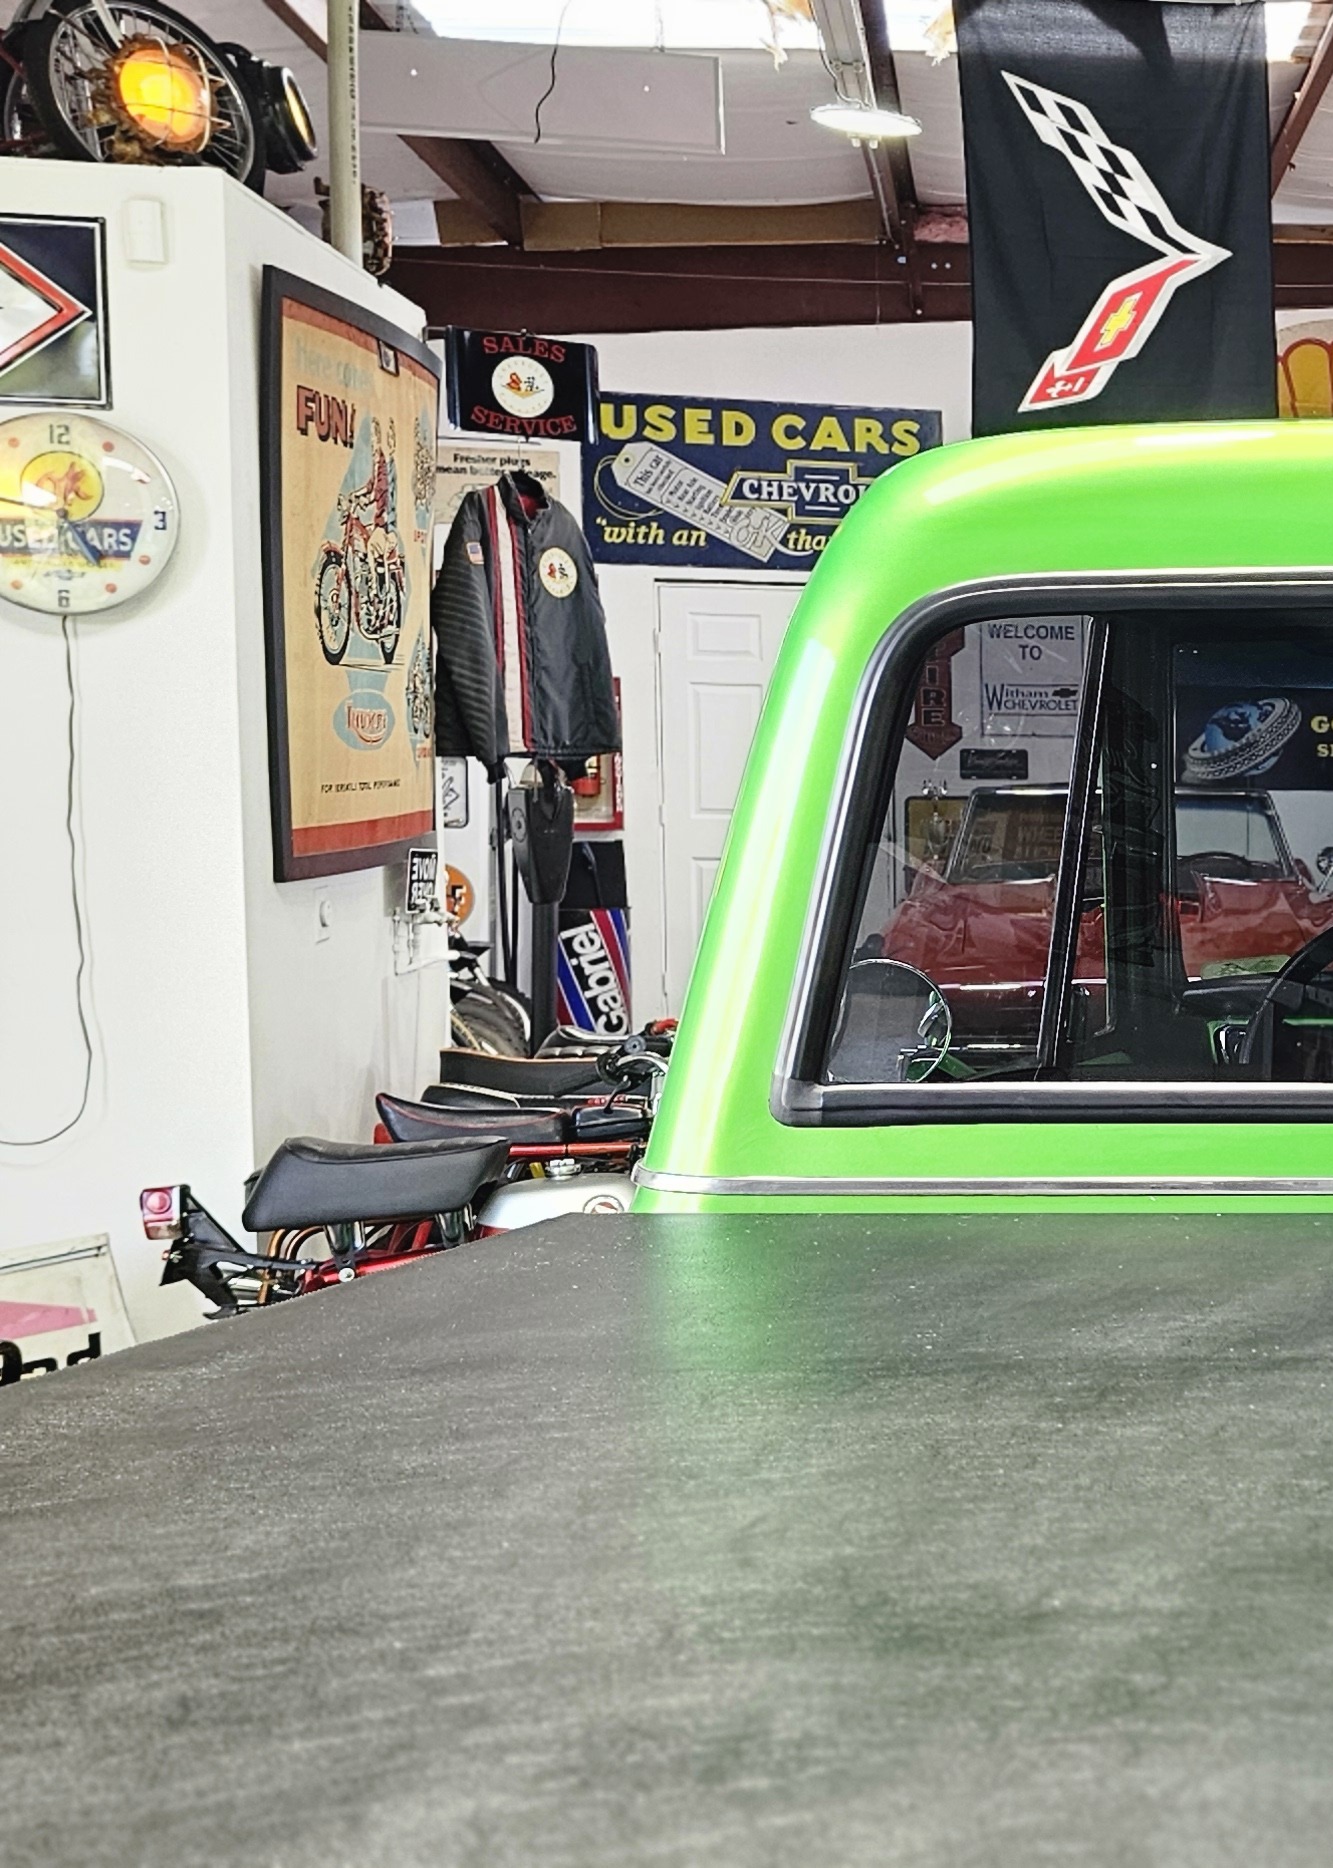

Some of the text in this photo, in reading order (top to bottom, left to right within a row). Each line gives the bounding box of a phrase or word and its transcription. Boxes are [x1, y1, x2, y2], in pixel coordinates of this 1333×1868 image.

[483, 336, 566, 363] SALES
[297, 385, 356, 449] FUN!
[470, 404, 577, 436] SERVICE
[600, 403, 756, 446] USED
[771, 413, 921, 457] CARS
[742, 479, 867, 505] CHEVRO
[672, 529, 707, 548] an
[787, 528, 832, 551] tha
[988, 623, 1076, 641] WELCOME
[1018, 644, 1043, 661] TO
[1003, 699, 1078, 711] CHEVROLET
[557, 922, 628, 1037] Gabriel
